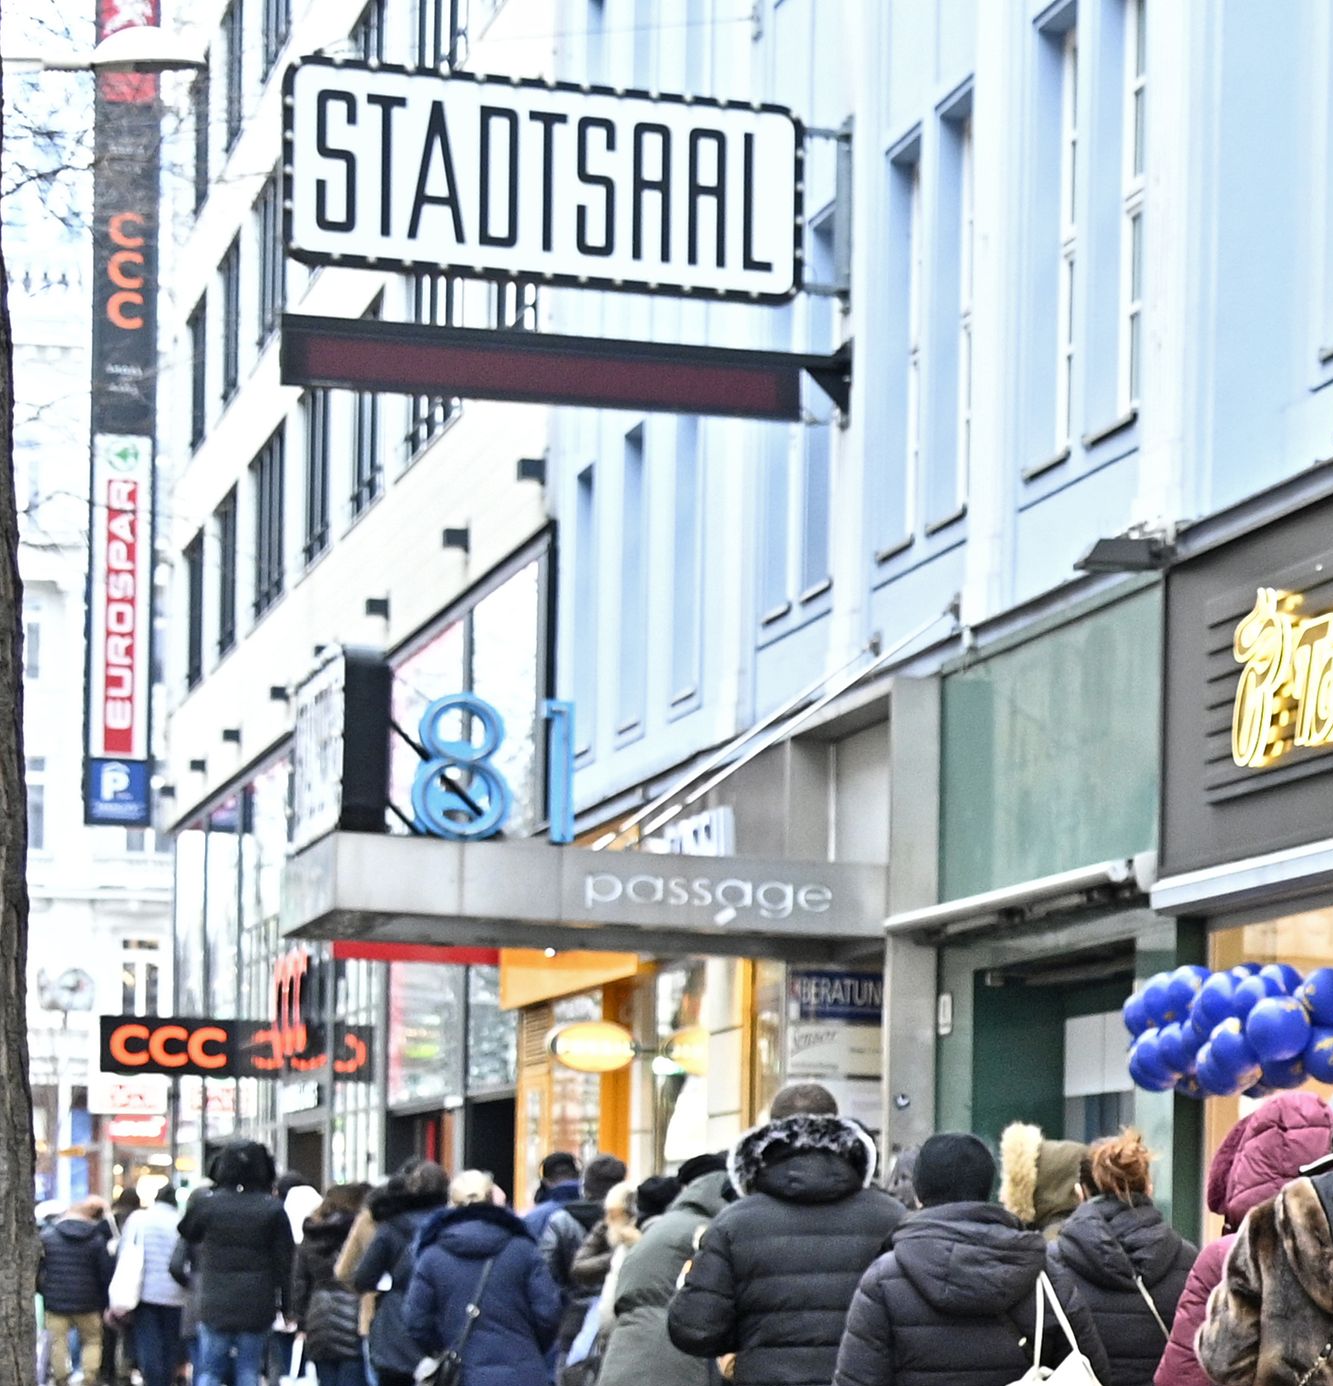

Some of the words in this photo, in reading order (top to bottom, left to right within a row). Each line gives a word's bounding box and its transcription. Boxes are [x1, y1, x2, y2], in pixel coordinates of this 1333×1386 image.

[315, 88, 774, 273] STADTSAAL
[105, 479, 138, 731] EUROSPAR
[584, 872, 833, 919] passage
[109, 1023, 228, 1069] CCC
